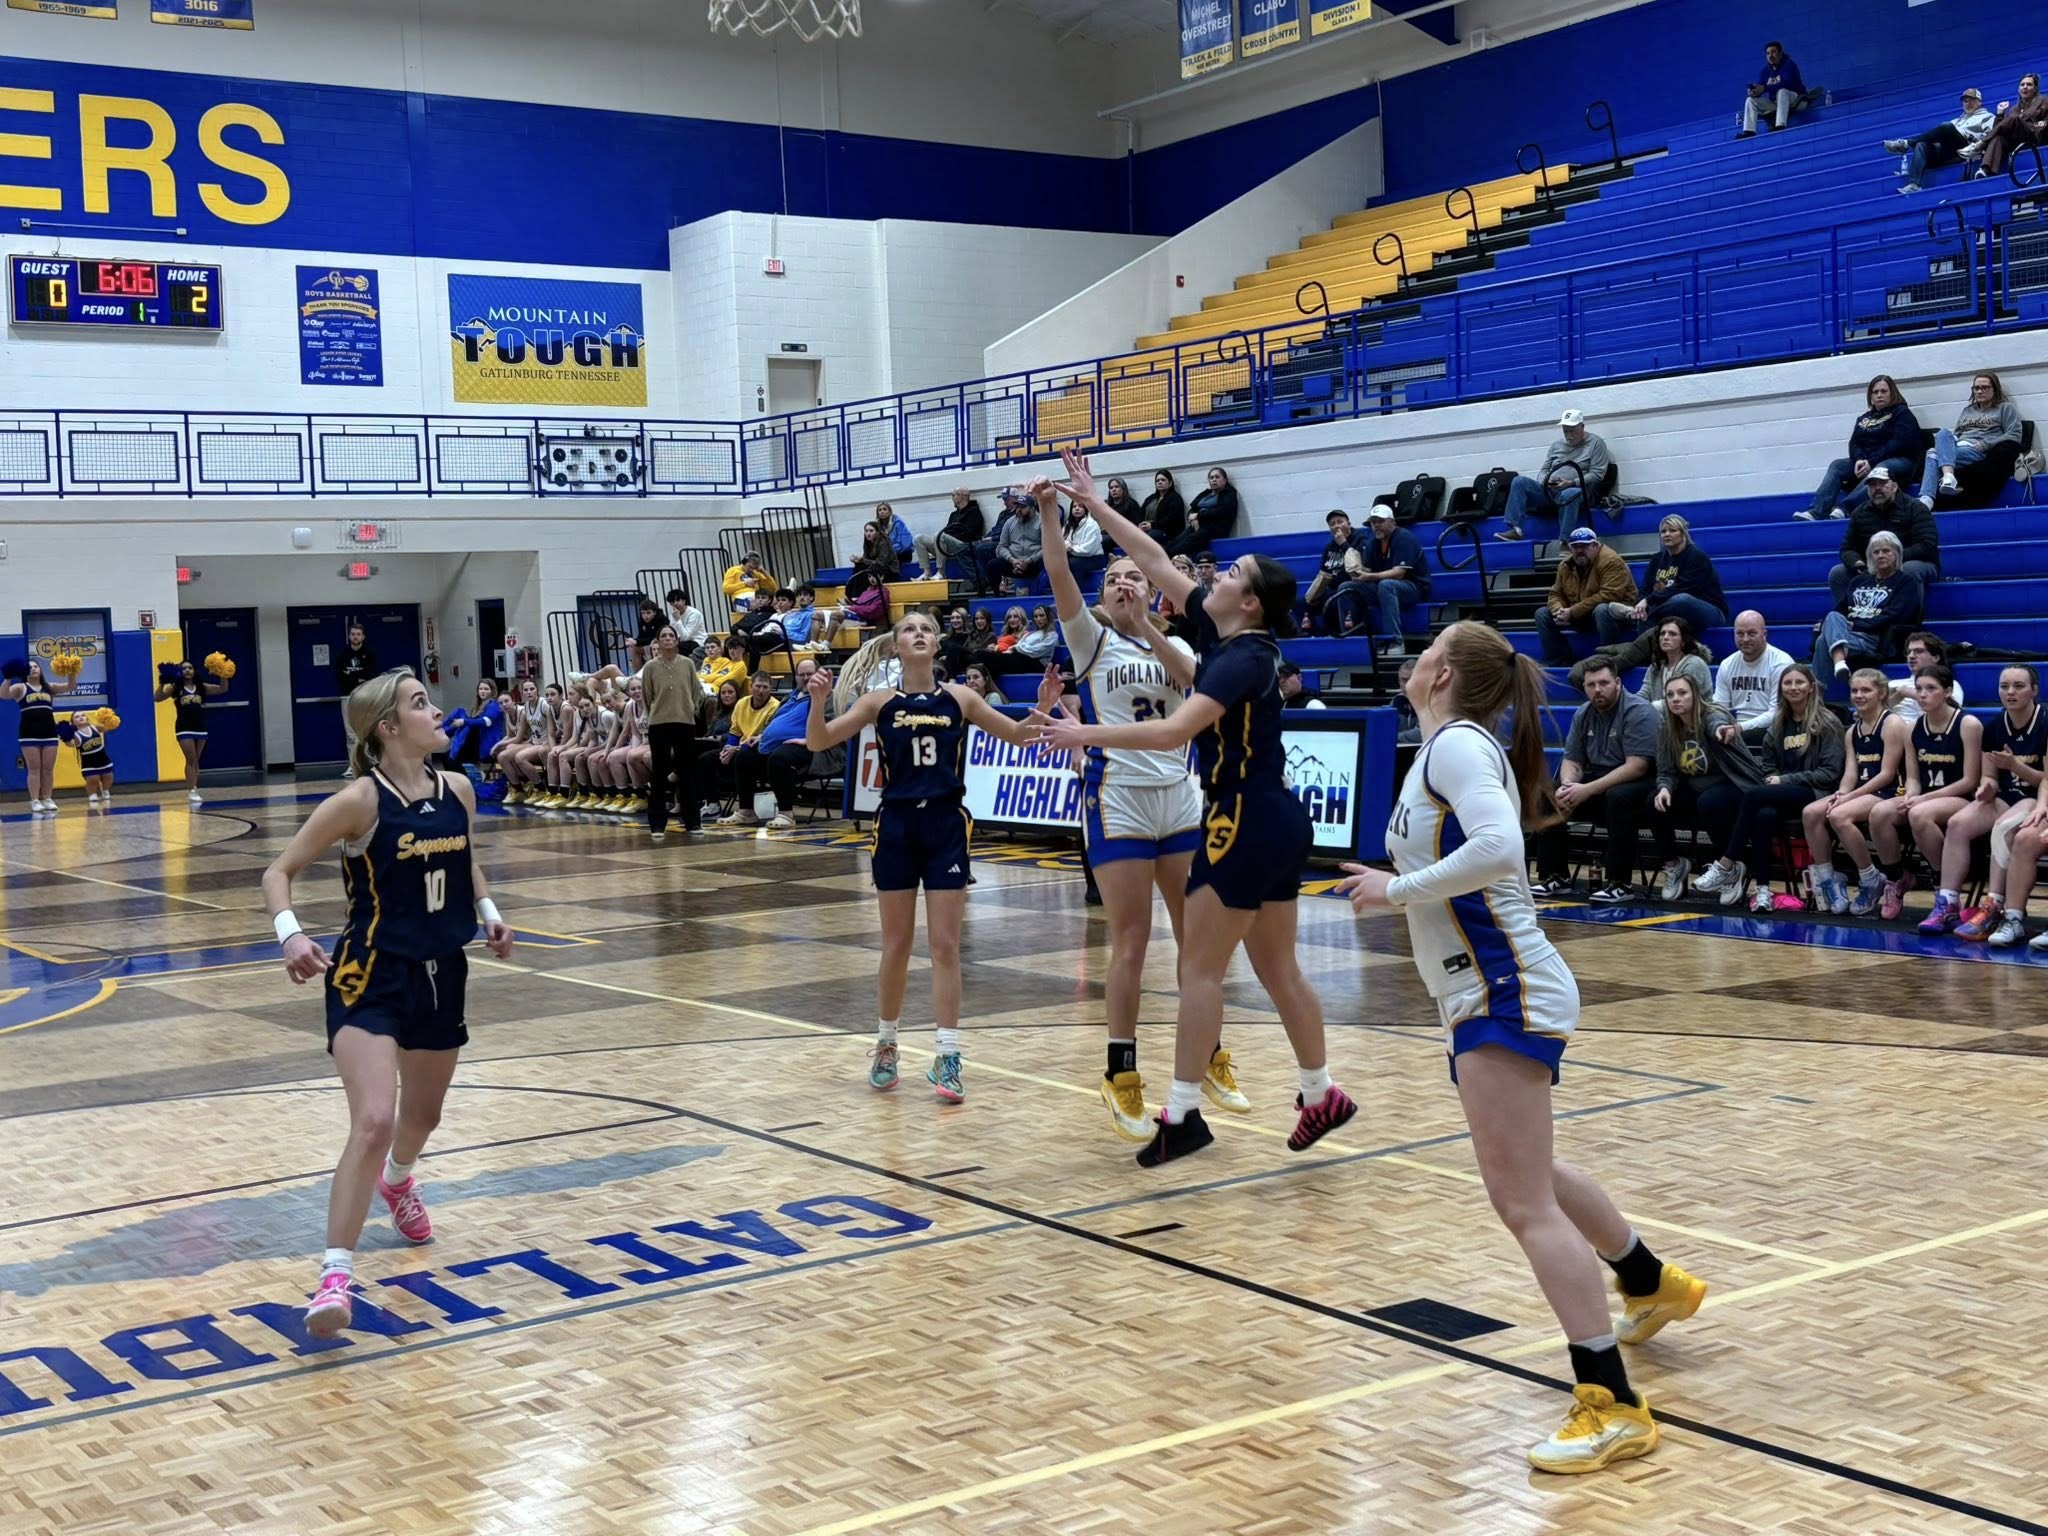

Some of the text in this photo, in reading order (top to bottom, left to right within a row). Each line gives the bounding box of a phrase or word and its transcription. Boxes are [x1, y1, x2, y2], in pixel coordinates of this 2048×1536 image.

[1191, 1, 1221, 20] MICHEL
[1254, 0, 1287, 16] CLABO
[1323, 6, 1354, 22] DIVISION
[1182, 14, 1232, 42] OVERSTREET
[1244, 27, 1298, 50] CROSS COUNTRY
[1184, 54, 1206, 67] TRACK
[0, 87, 290, 225] ERS
[21, 262, 209, 293] GUEST 6:06 HOME
[50, 279, 67, 308] 0
[81, 305, 124, 317] PERIOD
[138, 302, 146, 322] 1
[191, 286, 208, 313] 2
[326, 291, 373, 300] BASKETBALL
[340, 302, 370, 313] SPONSORS
[488, 307, 607, 326] MOUNTAIN
[456, 325, 640, 369] TOUGH
[480, 368, 621, 382] GATLINBURG TENNESSEE
[1107, 663, 1184, 700] HIGHLAND
[911, 736, 937, 767] 13
[970, 730, 1073, 770] GATLINBU
[1287, 771, 1350, 786] NTAIN
[1927, 770, 1945, 787] 14
[993, 774, 1082, 821] HIGHLA
[1209, 827, 1232, 849] S
[424, 868, 446, 913] 10
